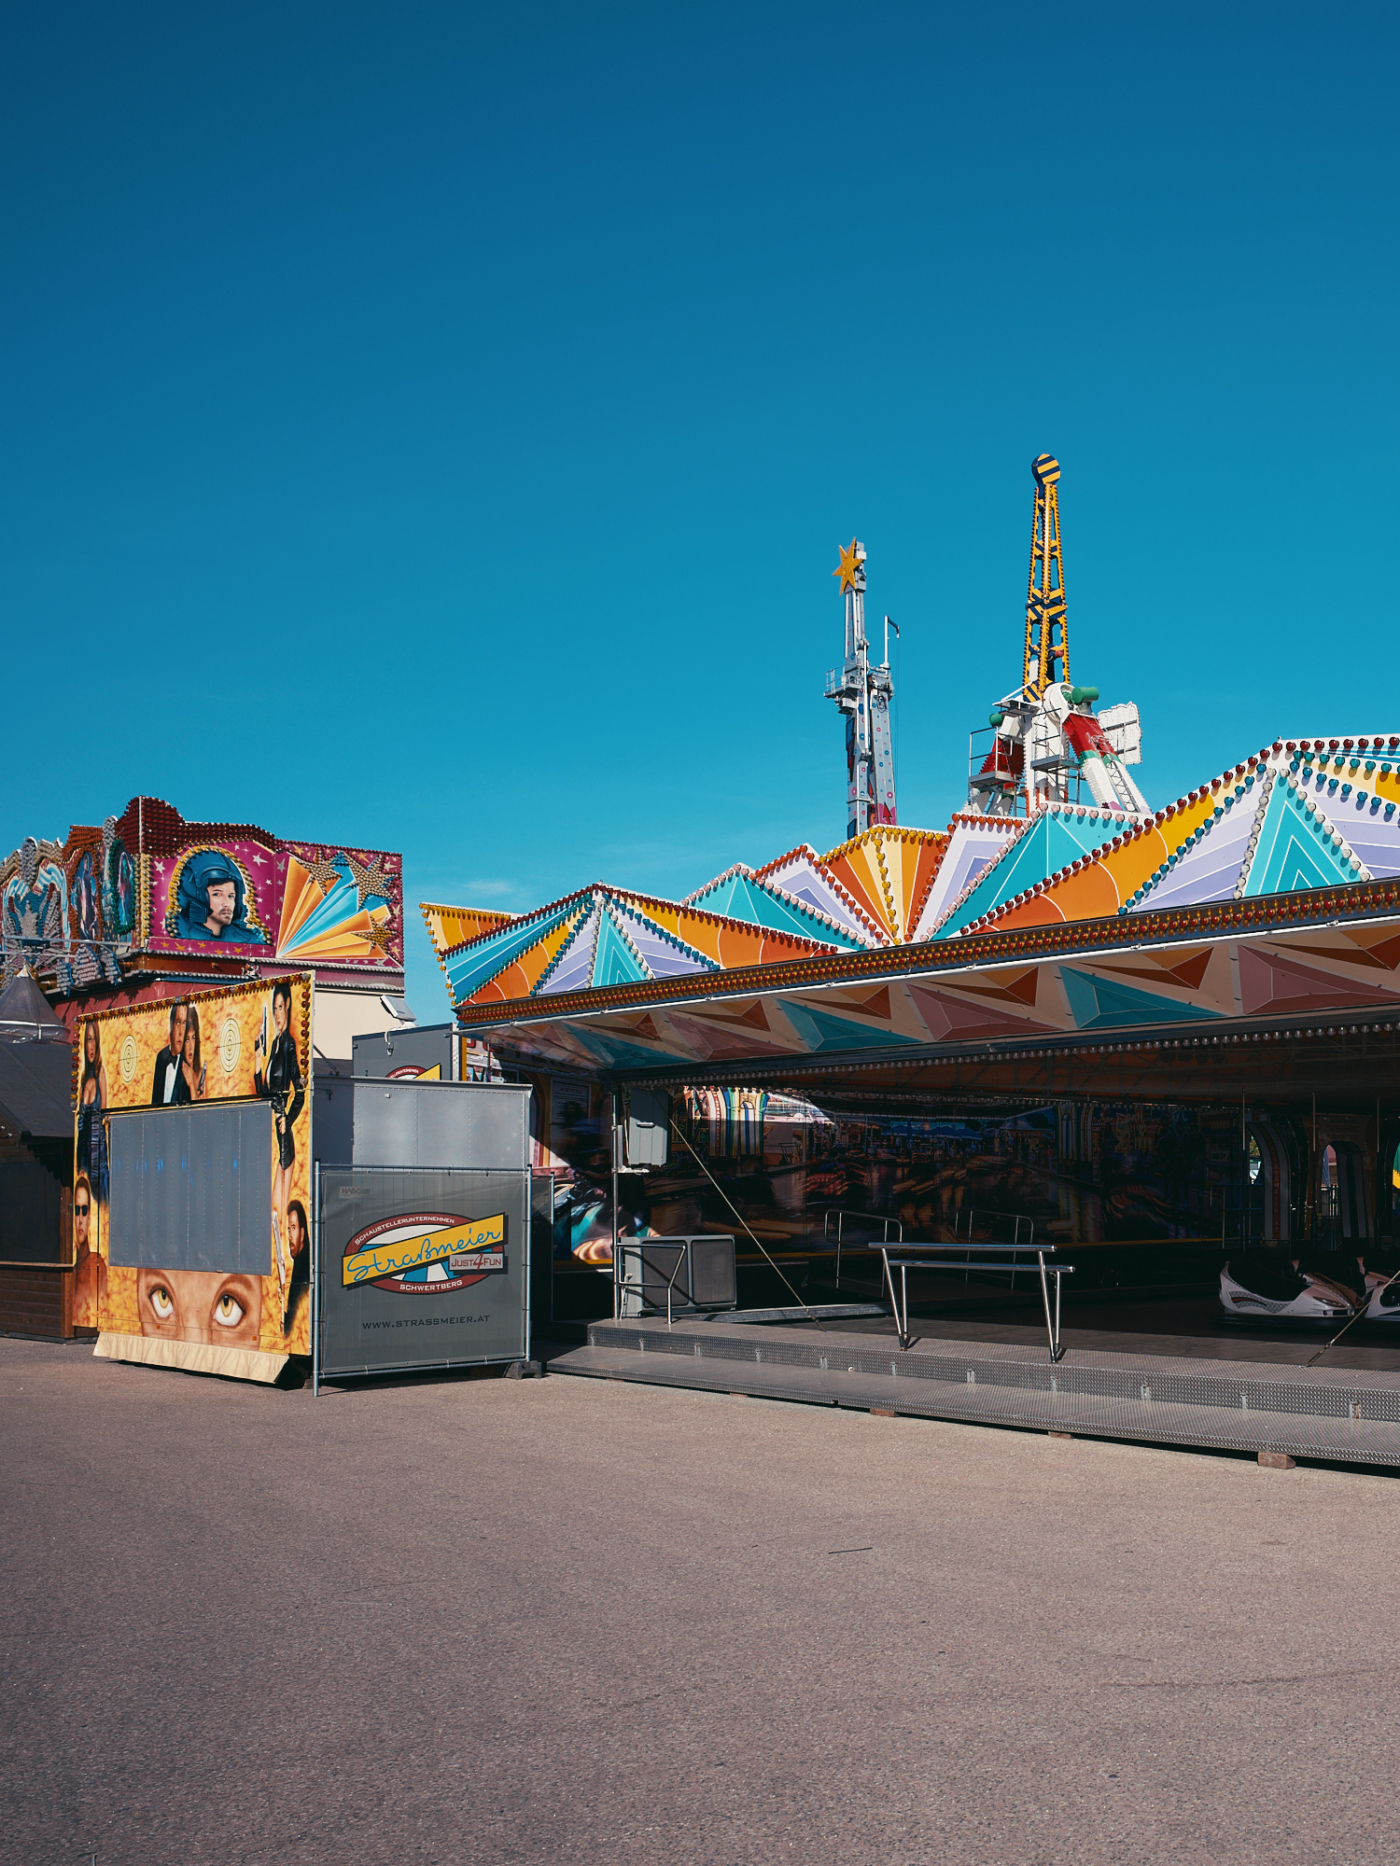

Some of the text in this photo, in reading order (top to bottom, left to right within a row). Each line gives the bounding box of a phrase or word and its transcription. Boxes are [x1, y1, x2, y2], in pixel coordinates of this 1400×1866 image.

[354, 1216, 456, 1246] SCHAUSTELLERUNTERNEHMEN
[346, 1227, 501, 1282] Straßmeier
[400, 1279, 463, 1291] SCHWERTBERG
[362, 1314, 490, 1330] WWW.STRASSMEIER.AT
